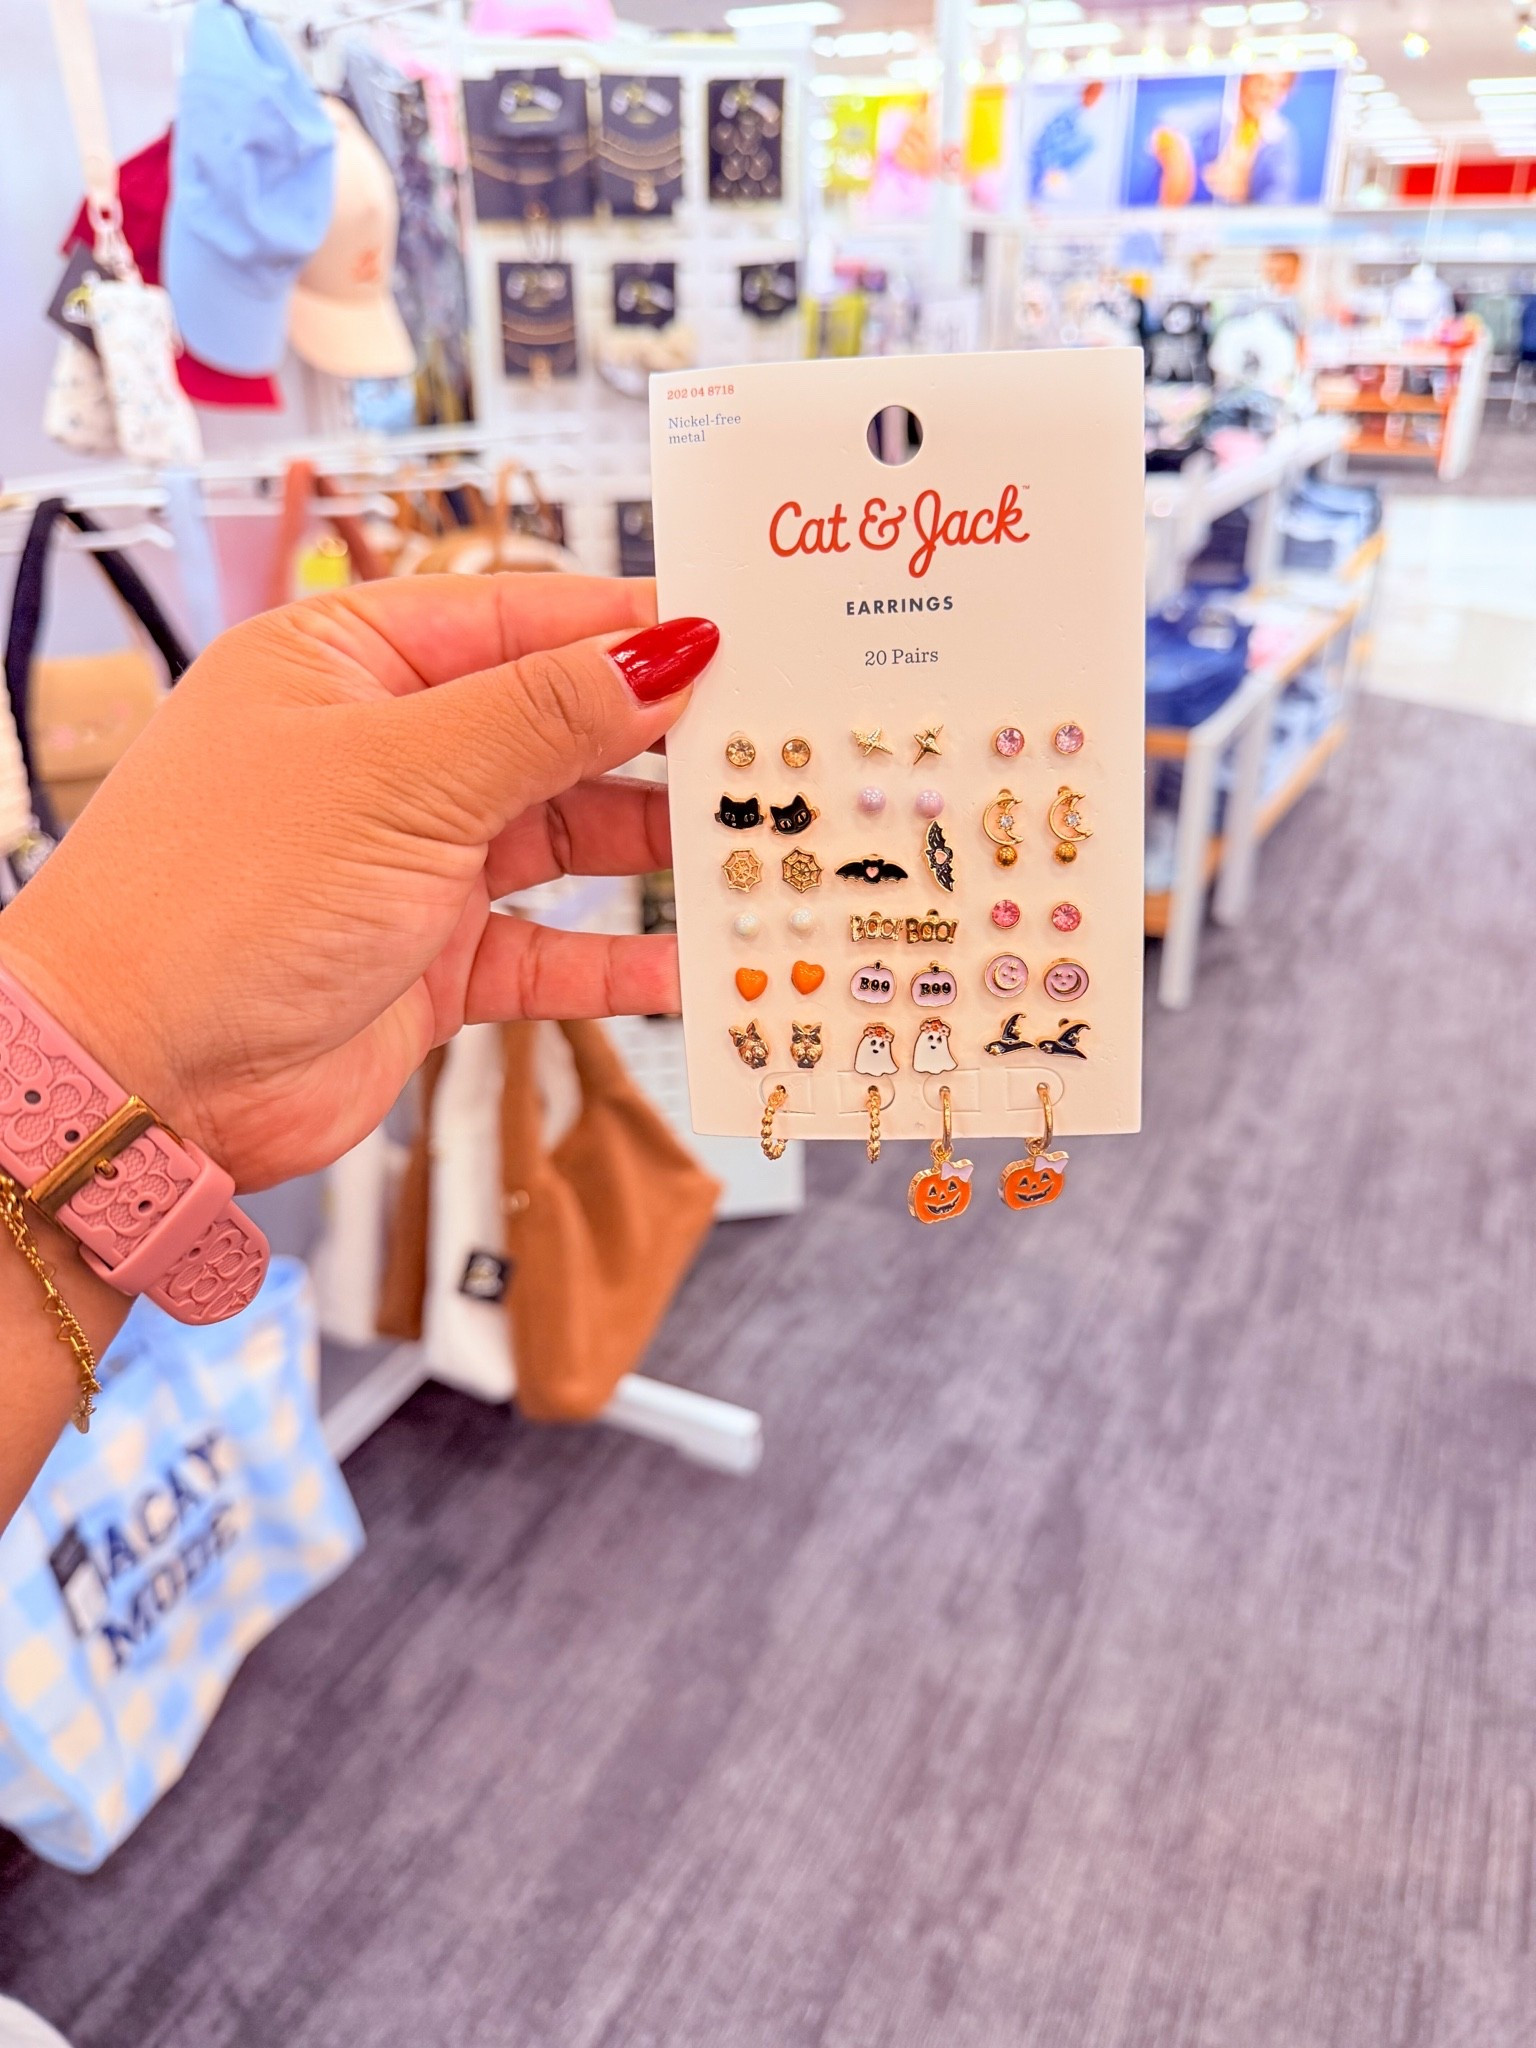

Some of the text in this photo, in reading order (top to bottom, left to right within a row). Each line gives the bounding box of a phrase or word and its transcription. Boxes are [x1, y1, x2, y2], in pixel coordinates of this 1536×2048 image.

[667, 384, 735, 400] 202 04 8718
[668, 413, 742, 429] Nickel-free
[669, 429, 706, 444] metal
[769, 501, 850, 557] Cat
[858, 497, 907, 551] &
[908, 484, 1030, 578] Jack
[846, 596, 954, 615] EARRINGS
[864, 647, 939, 666] 20 Pairs
[860, 976, 890, 992] BOO
[919, 982, 951, 997] BOO
[84, 1432, 222, 1603] ACAY
